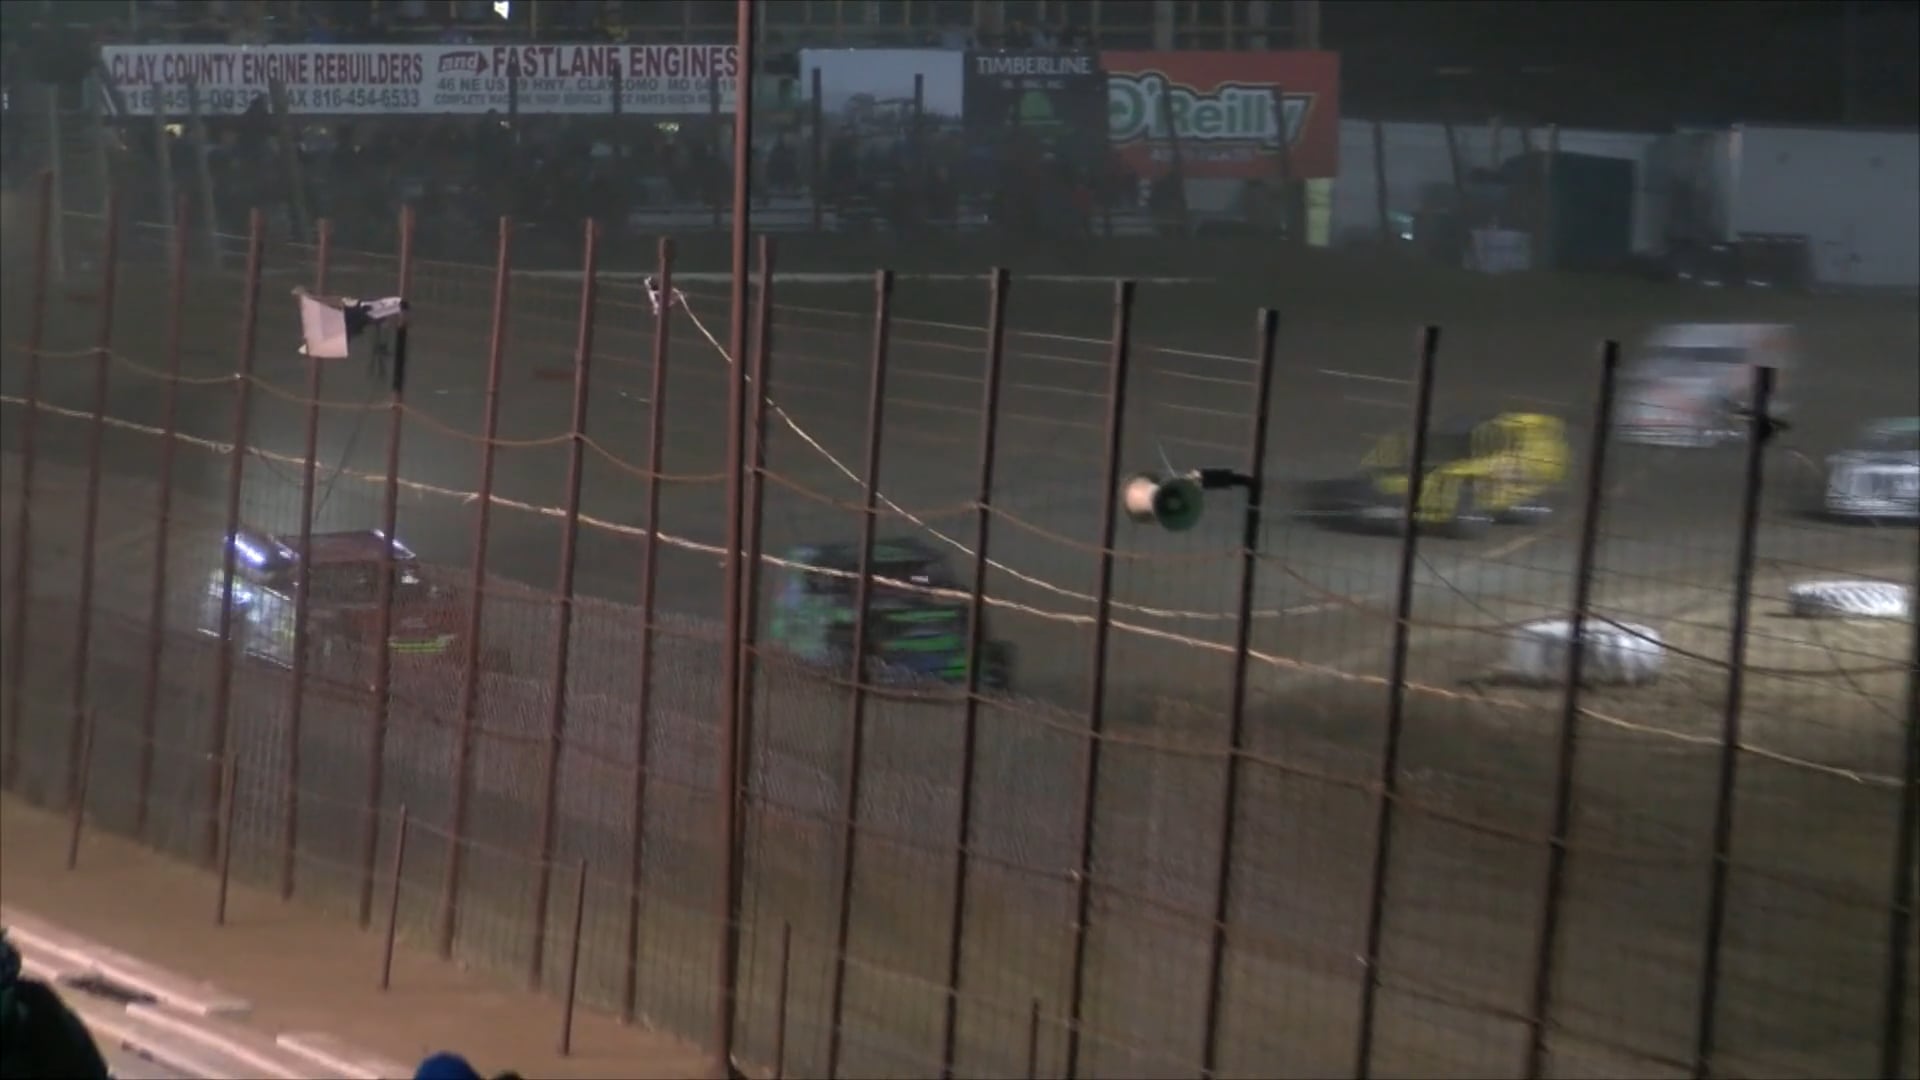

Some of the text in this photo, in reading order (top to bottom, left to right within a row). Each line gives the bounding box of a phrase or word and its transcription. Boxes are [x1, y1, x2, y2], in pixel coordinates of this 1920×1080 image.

[112, 53, 424, 86] CLAY COUNTY ENGINE REBUILDERS
[441, 46, 739, 77] and FASTLANE ENGINES
[976, 55, 1093, 75] TIMBERLINE
[488, 78, 508, 92] US
[313, 88, 421, 107] 816-454-6533
